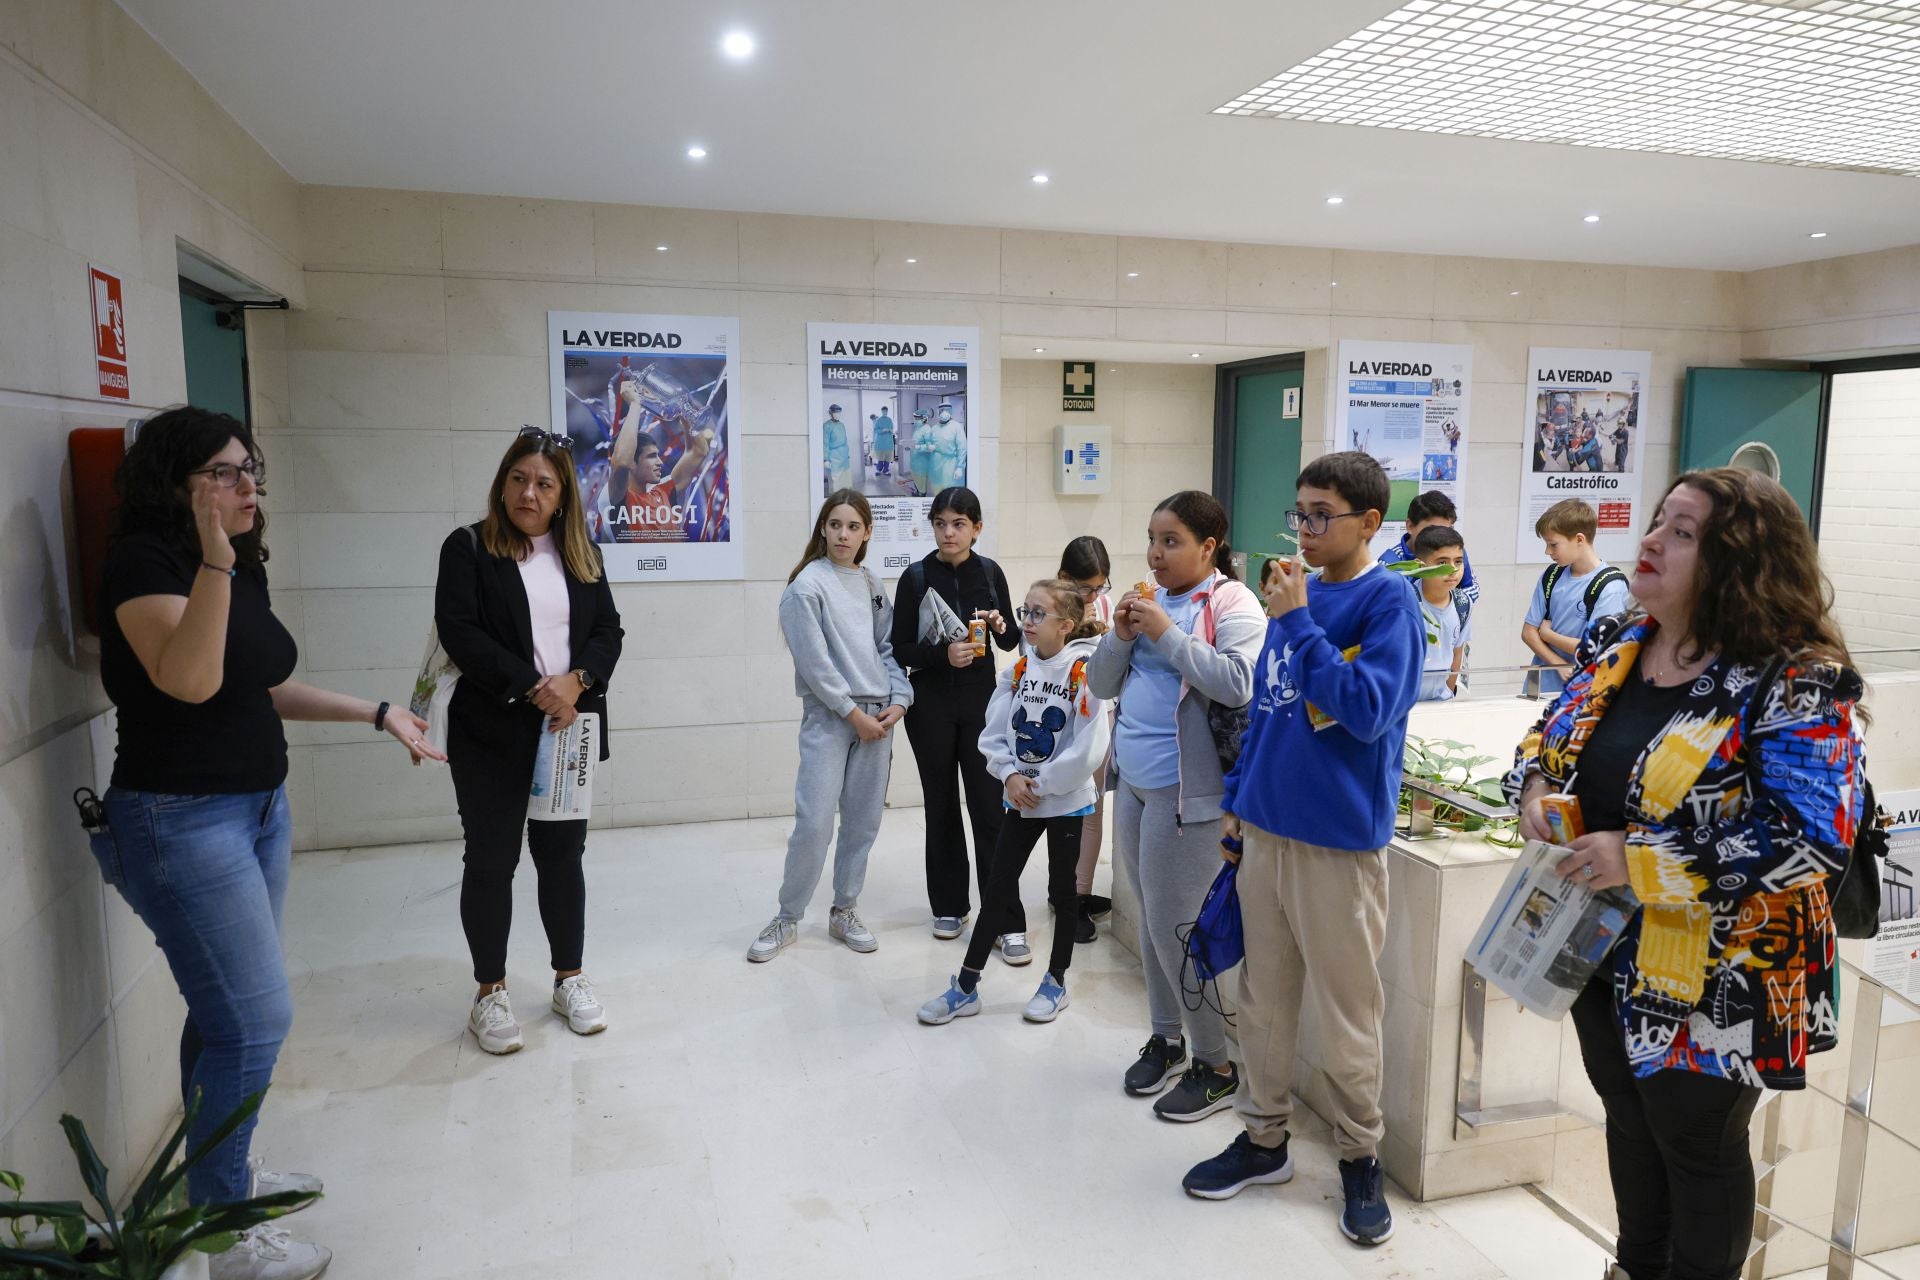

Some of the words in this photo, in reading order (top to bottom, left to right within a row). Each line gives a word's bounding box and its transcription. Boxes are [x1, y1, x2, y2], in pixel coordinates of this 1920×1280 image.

[563, 330, 592, 346] LA
[594, 331, 682, 348] VERDAD
[821, 340, 847, 356] LA
[849, 341, 927, 356] VERDAD
[828, 368, 870, 380] Héroes
[872, 368, 888, 380] de
[890, 368, 900, 380] la
[902, 370, 958, 382] pandemia
[1349, 361, 1370, 374] LA
[1372, 362, 1432, 376] VERDAD
[1538, 369, 1556, 382] LA
[1558, 370, 1612, 383] VERDAD
[100, 370, 129, 389] MANGUERA
[1064, 400, 1094, 409] BOTIQUIN
[1546, 476, 1618, 488] Catastrófico
[604, 505, 682, 524] CARLOS
[689, 505, 698, 524] I
[1024, 696, 1048, 704] DISNEY
[582, 718, 591, 736] LA
[578, 736, 590, 786] VERDAD
